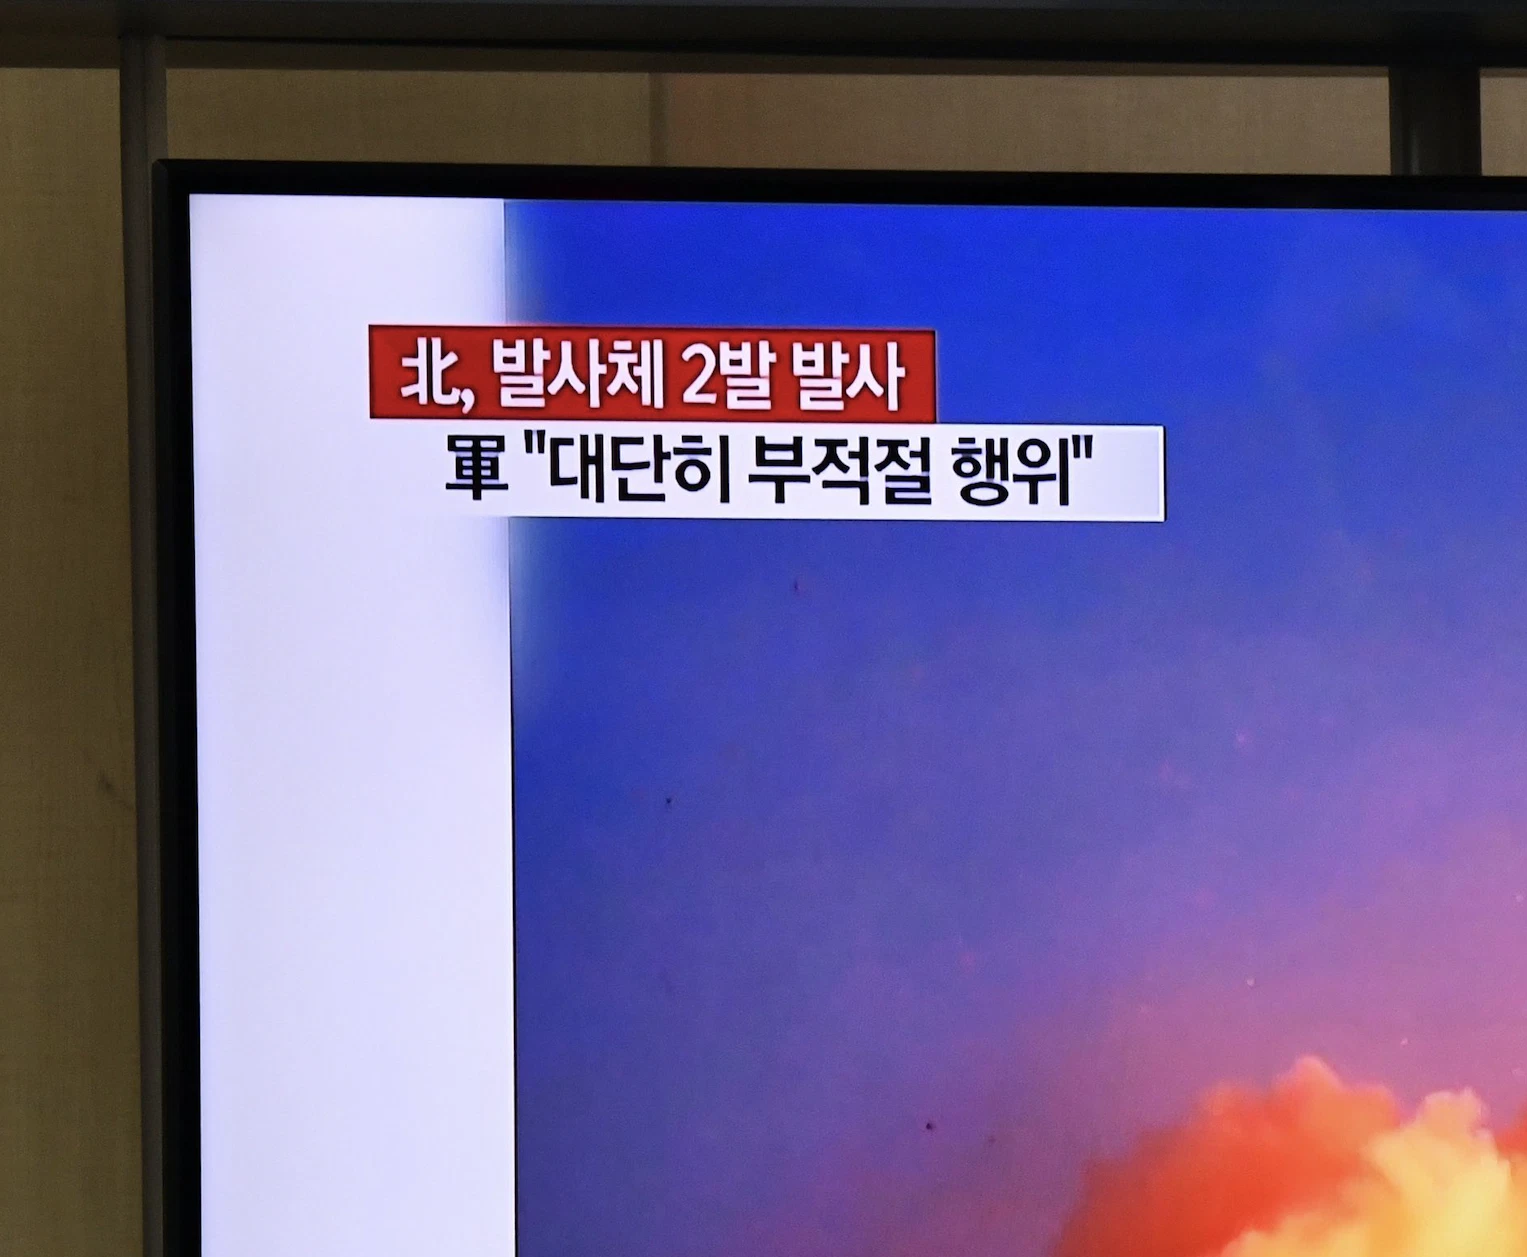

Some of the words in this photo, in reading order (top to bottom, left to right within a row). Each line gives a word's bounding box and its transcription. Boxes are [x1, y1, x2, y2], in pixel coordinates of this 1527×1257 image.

[400, 337, 475, 414] 北,
[493, 338, 664, 409] 발사체
[681, 340, 775, 410] 2발
[792, 341, 906, 411] 발사
[445, 434, 509, 501] 軍
[523, 429, 730, 504] "대단히
[748, 435, 932, 506] 부적절
[951, 434, 1093, 507] 행위"
